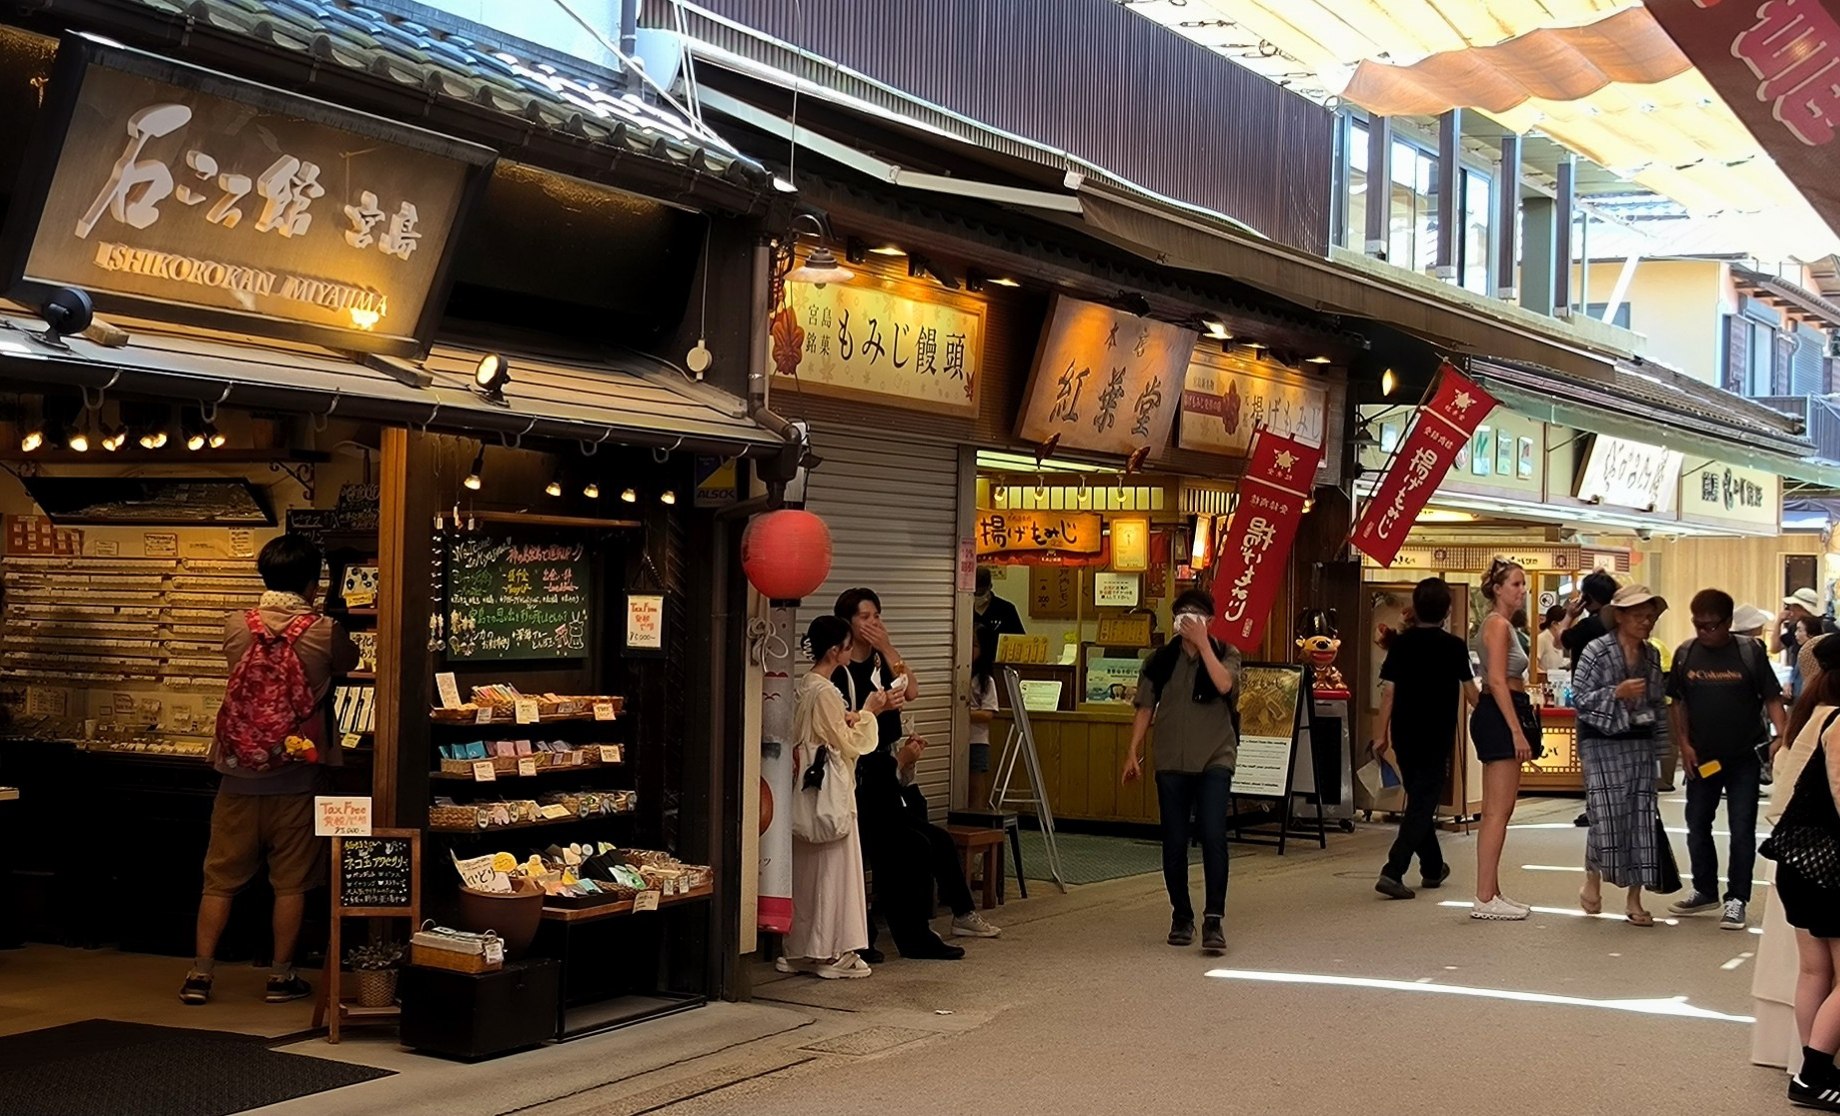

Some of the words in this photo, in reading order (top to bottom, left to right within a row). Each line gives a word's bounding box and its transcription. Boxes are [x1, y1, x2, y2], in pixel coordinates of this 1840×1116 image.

[75, 103, 325, 239] 石ころ館
[344, 190, 422, 261] 宮島
[93, 241, 277, 296] ISHIKOROKAN
[279, 275, 387, 317] MIYAJIMA
[808, 304, 832, 328] 宮島
[806, 332, 831, 356] 銘菓
[838, 308, 966, 380] もみじ饅頭
[697, 490, 735, 499] ALSOK
[1377, 447, 1438, 540] 揚げもみじ
[980, 514, 1077, 548] 揚げもみじ
[320, 803, 342, 815] Tax
[344, 802, 366, 815] Free
